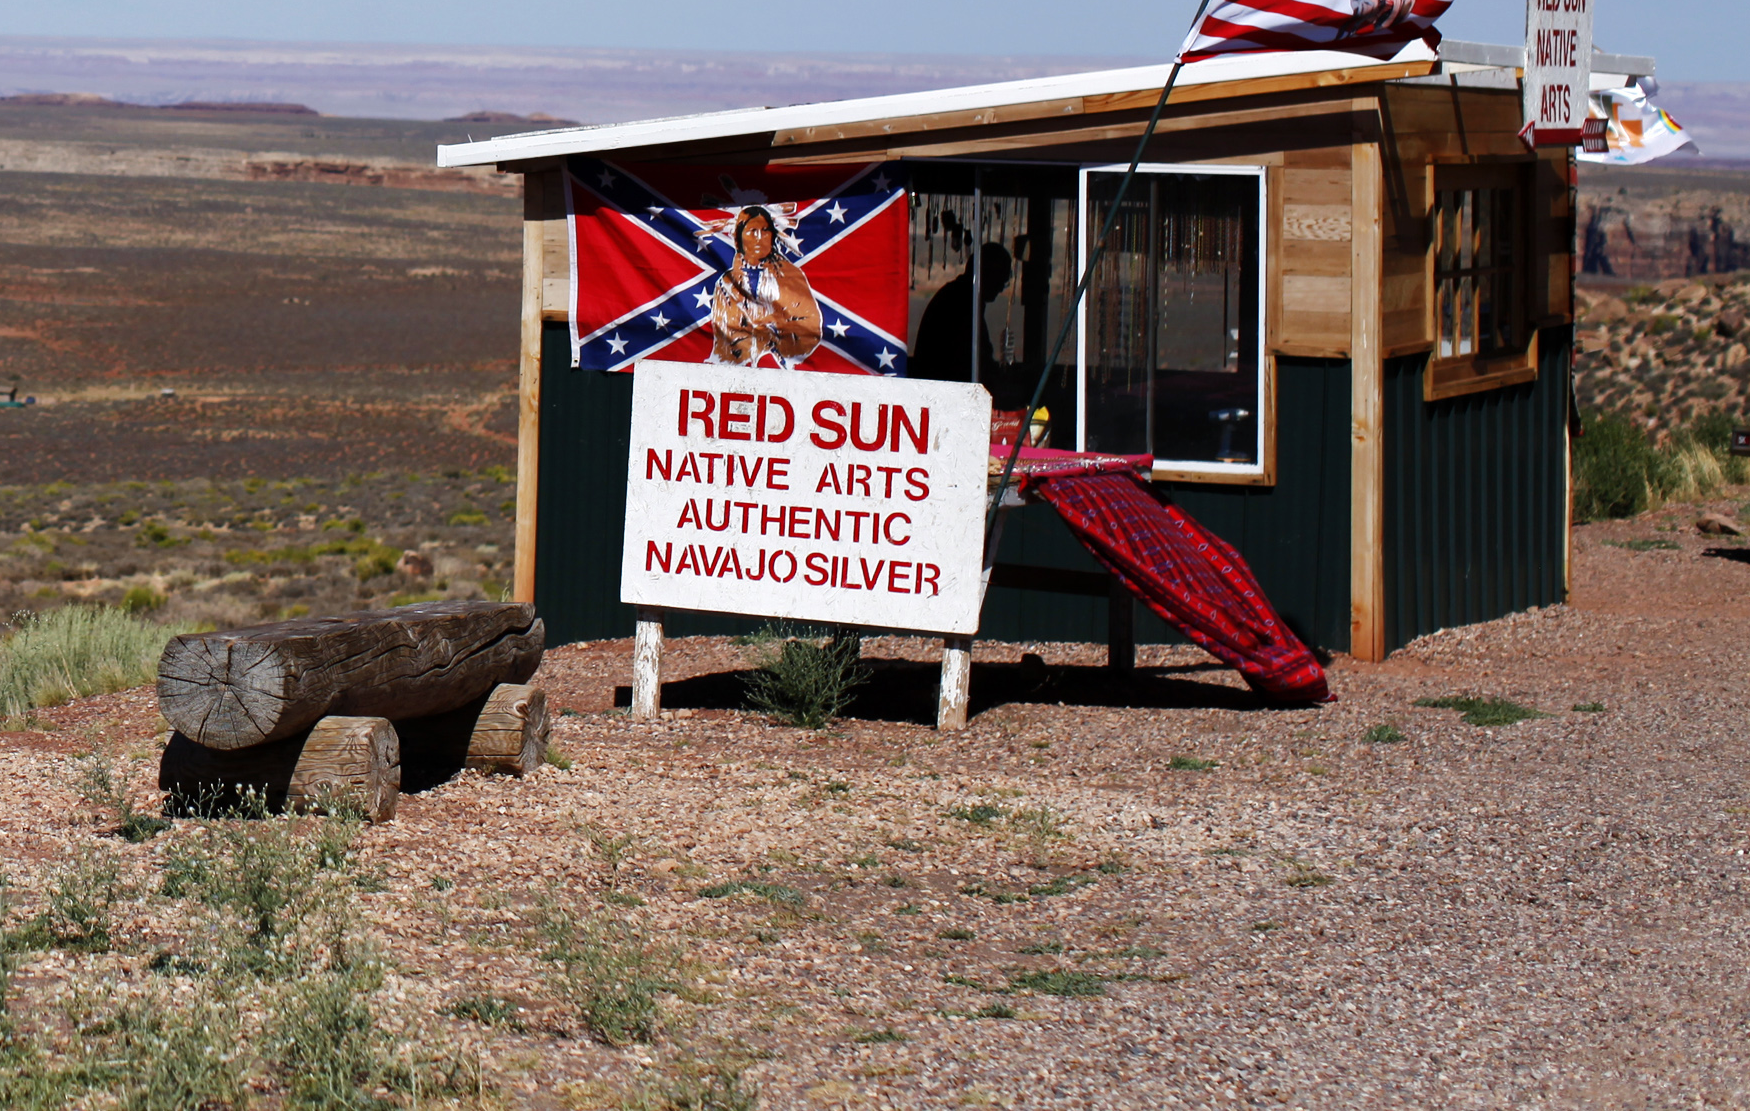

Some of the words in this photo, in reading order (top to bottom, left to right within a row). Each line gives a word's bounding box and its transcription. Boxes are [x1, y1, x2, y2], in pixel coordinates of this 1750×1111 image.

[1536, 28, 1577, 67] NATIVE
[1540, 84, 1571, 124] ARTS
[678, 389, 795, 443] RED
[809, 400, 930, 455] SUN
[646, 448, 791, 490] NATIVE
[816, 463, 930, 502] ARTS
[677, 498, 912, 546] AUTHENTIC
[645, 540, 798, 583] NAVAJO
[804, 552, 941, 596] SILVER
